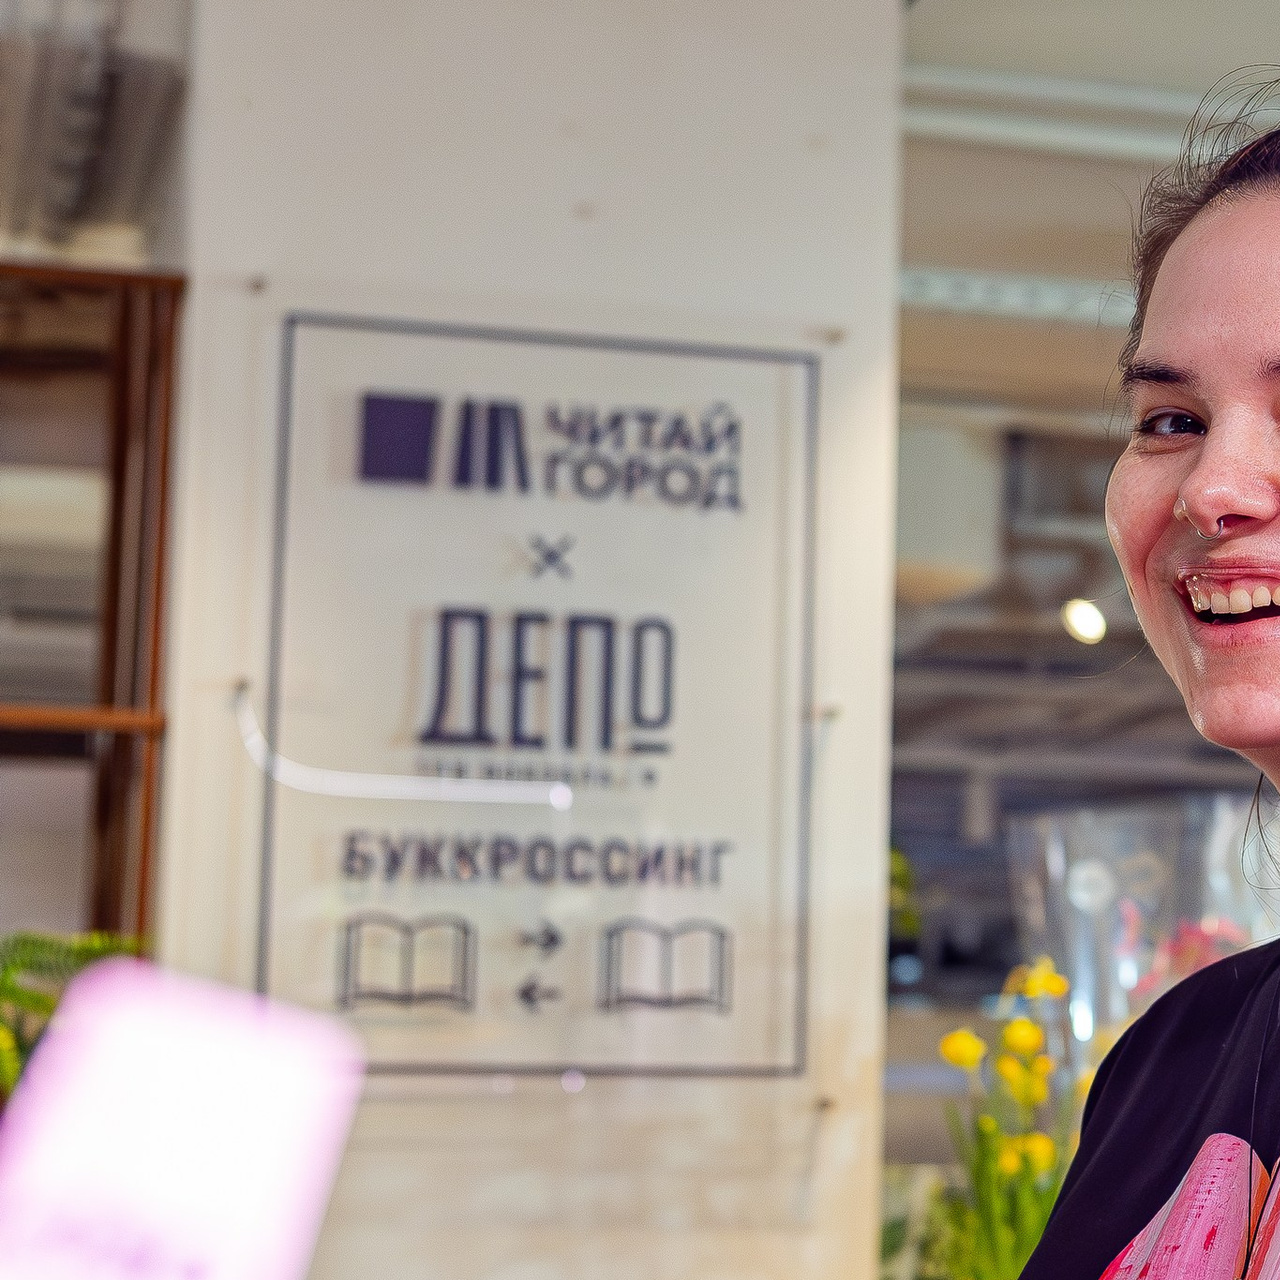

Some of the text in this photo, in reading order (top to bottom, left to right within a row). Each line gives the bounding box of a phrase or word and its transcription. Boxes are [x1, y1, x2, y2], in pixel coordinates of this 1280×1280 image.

[544, 400, 742, 456] ЧИТАЙ
[544, 449, 745, 513] ГОРОД
[418, 606, 676, 754] ДЕПО
[341, 830, 732, 888] БУККРОССИНГ
